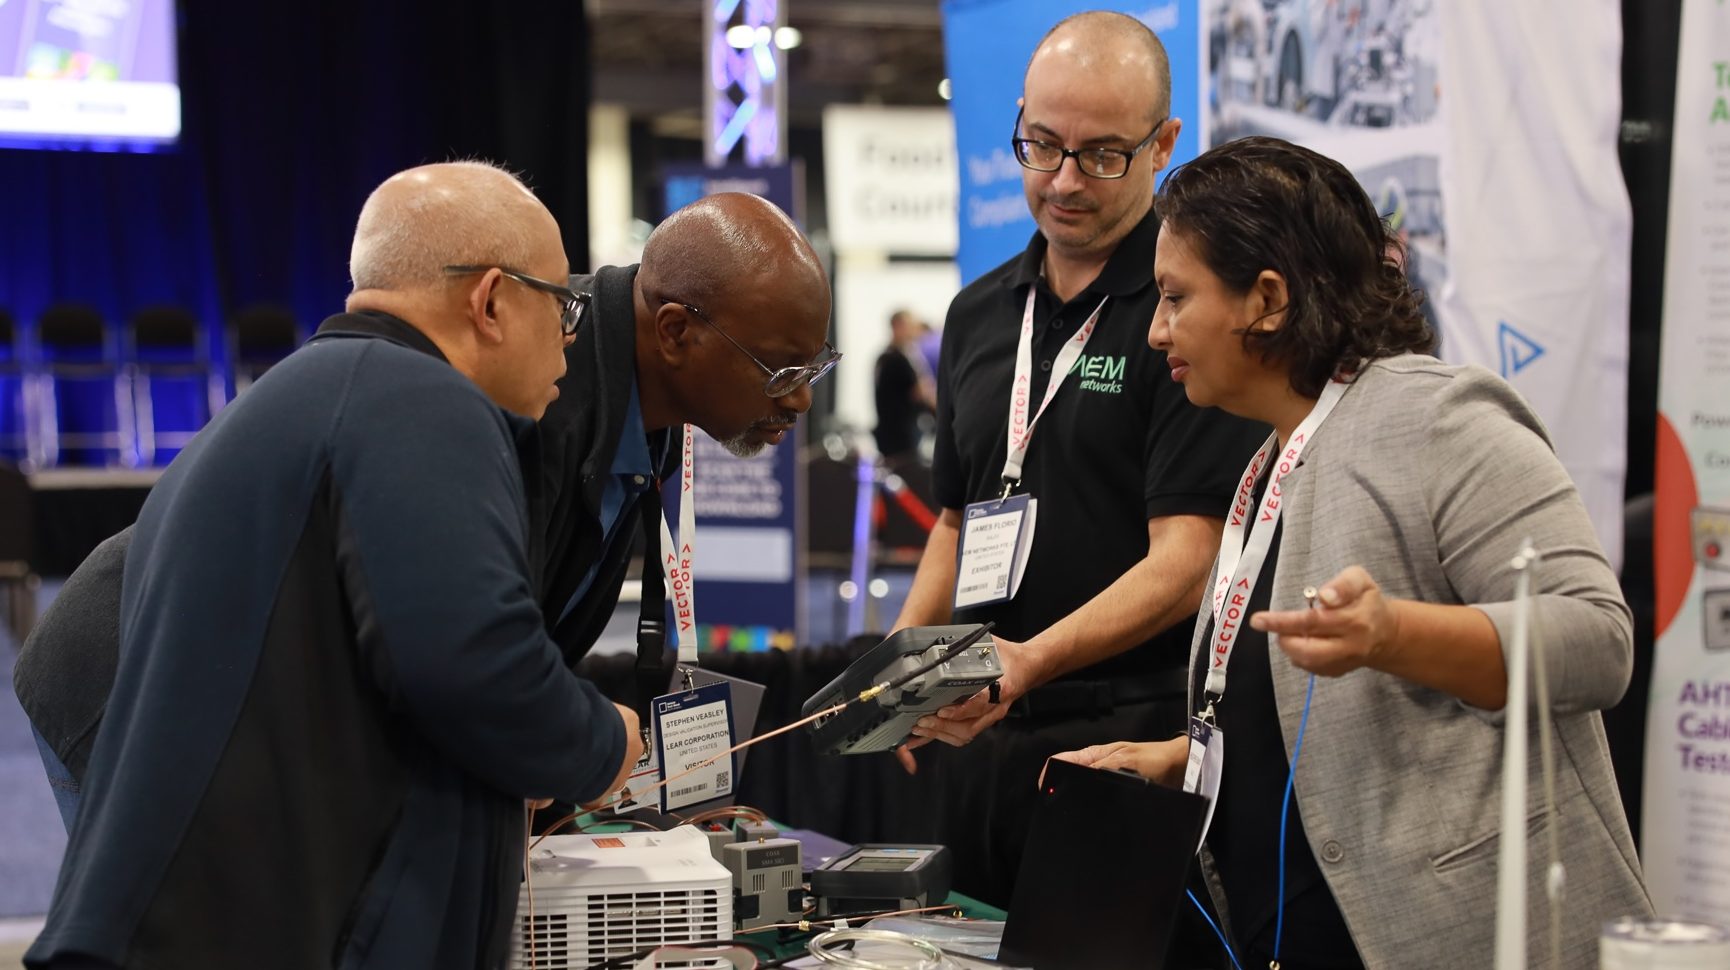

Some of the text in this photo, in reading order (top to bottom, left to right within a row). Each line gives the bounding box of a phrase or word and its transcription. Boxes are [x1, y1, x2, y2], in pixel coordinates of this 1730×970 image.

[1079, 379, 1123, 394] networks
[1230, 463, 1260, 528] VECTOR
[670, 567, 692, 632] VECTOR
[1214, 593, 1245, 668] VECTOR
[666, 709, 725, 729] STEPHEN VEASLEY
[666, 729, 730, 751] LEAR CORPORATION
[679, 741, 718, 757] UNITED STATES
